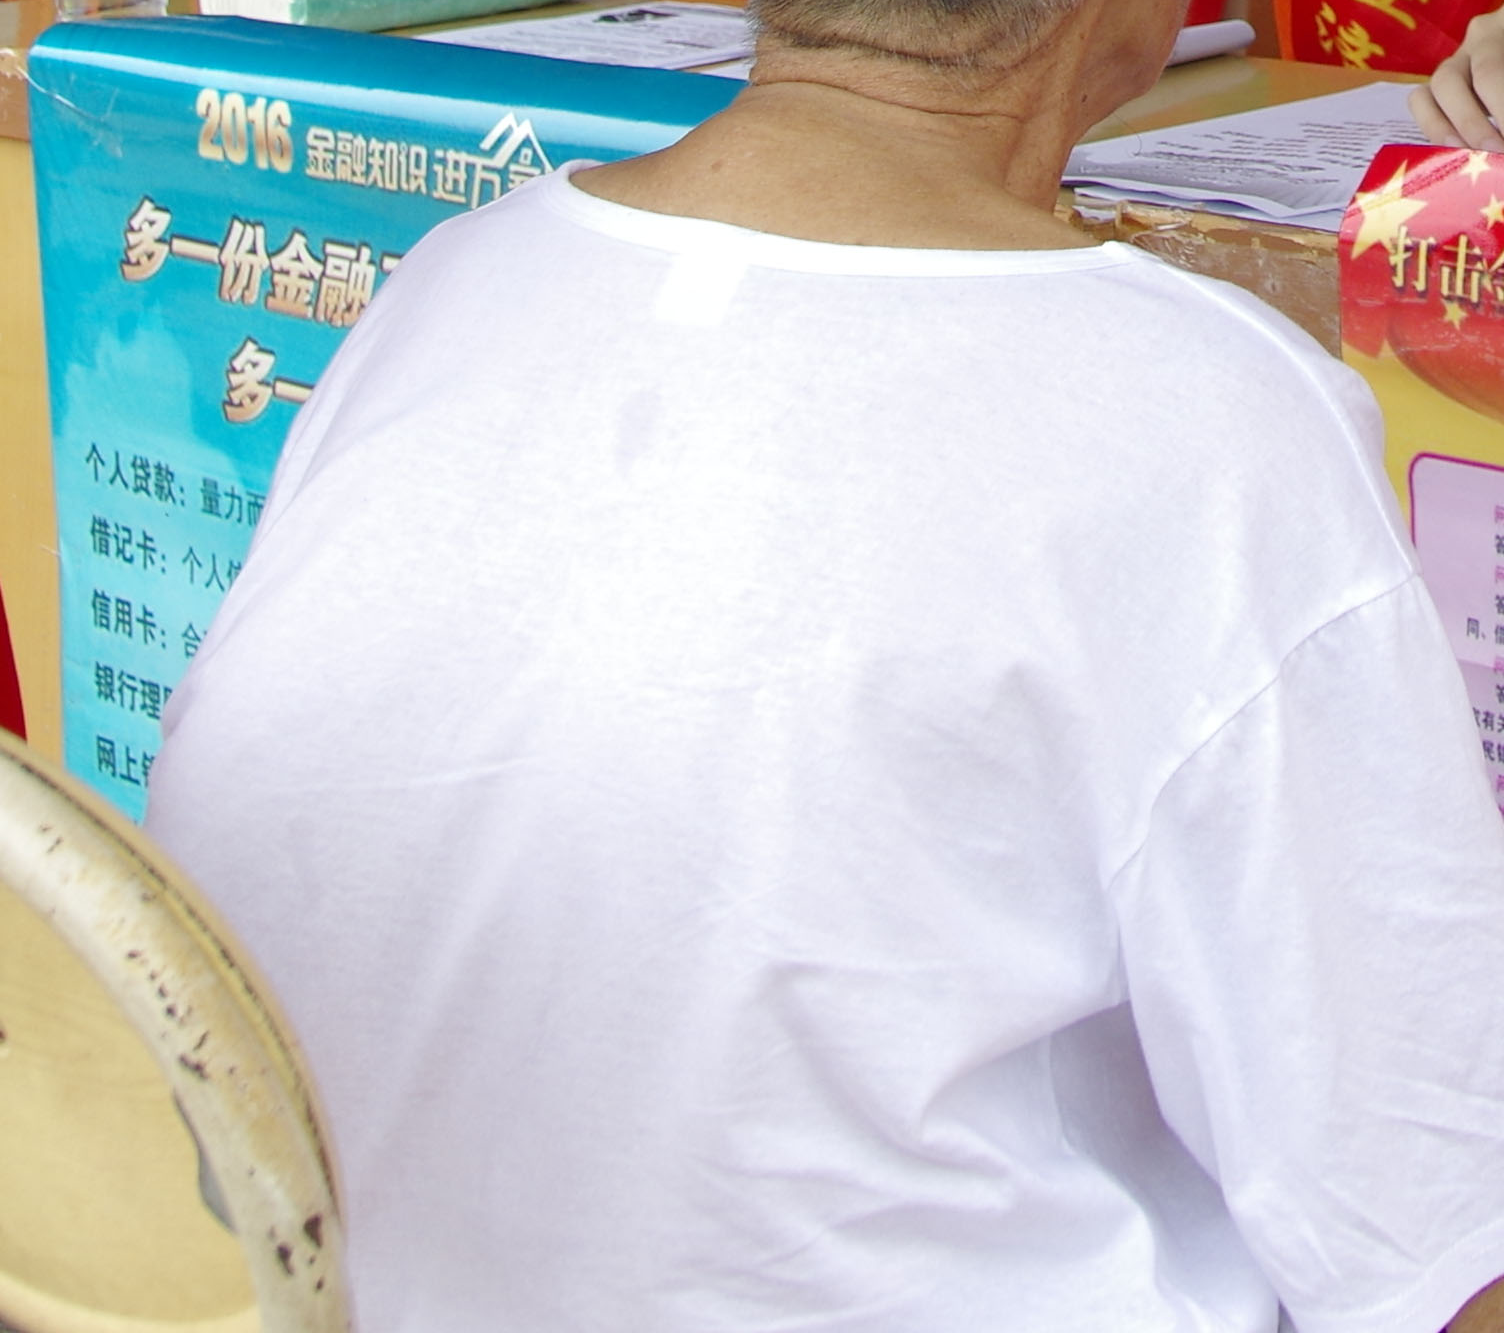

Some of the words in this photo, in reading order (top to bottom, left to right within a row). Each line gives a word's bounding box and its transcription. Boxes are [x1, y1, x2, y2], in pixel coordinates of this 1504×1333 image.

[196, 87, 294, 174] 2016
[120, 197, 403, 329] 多一份金融
[90, 588, 207, 662] 信用卡：合
